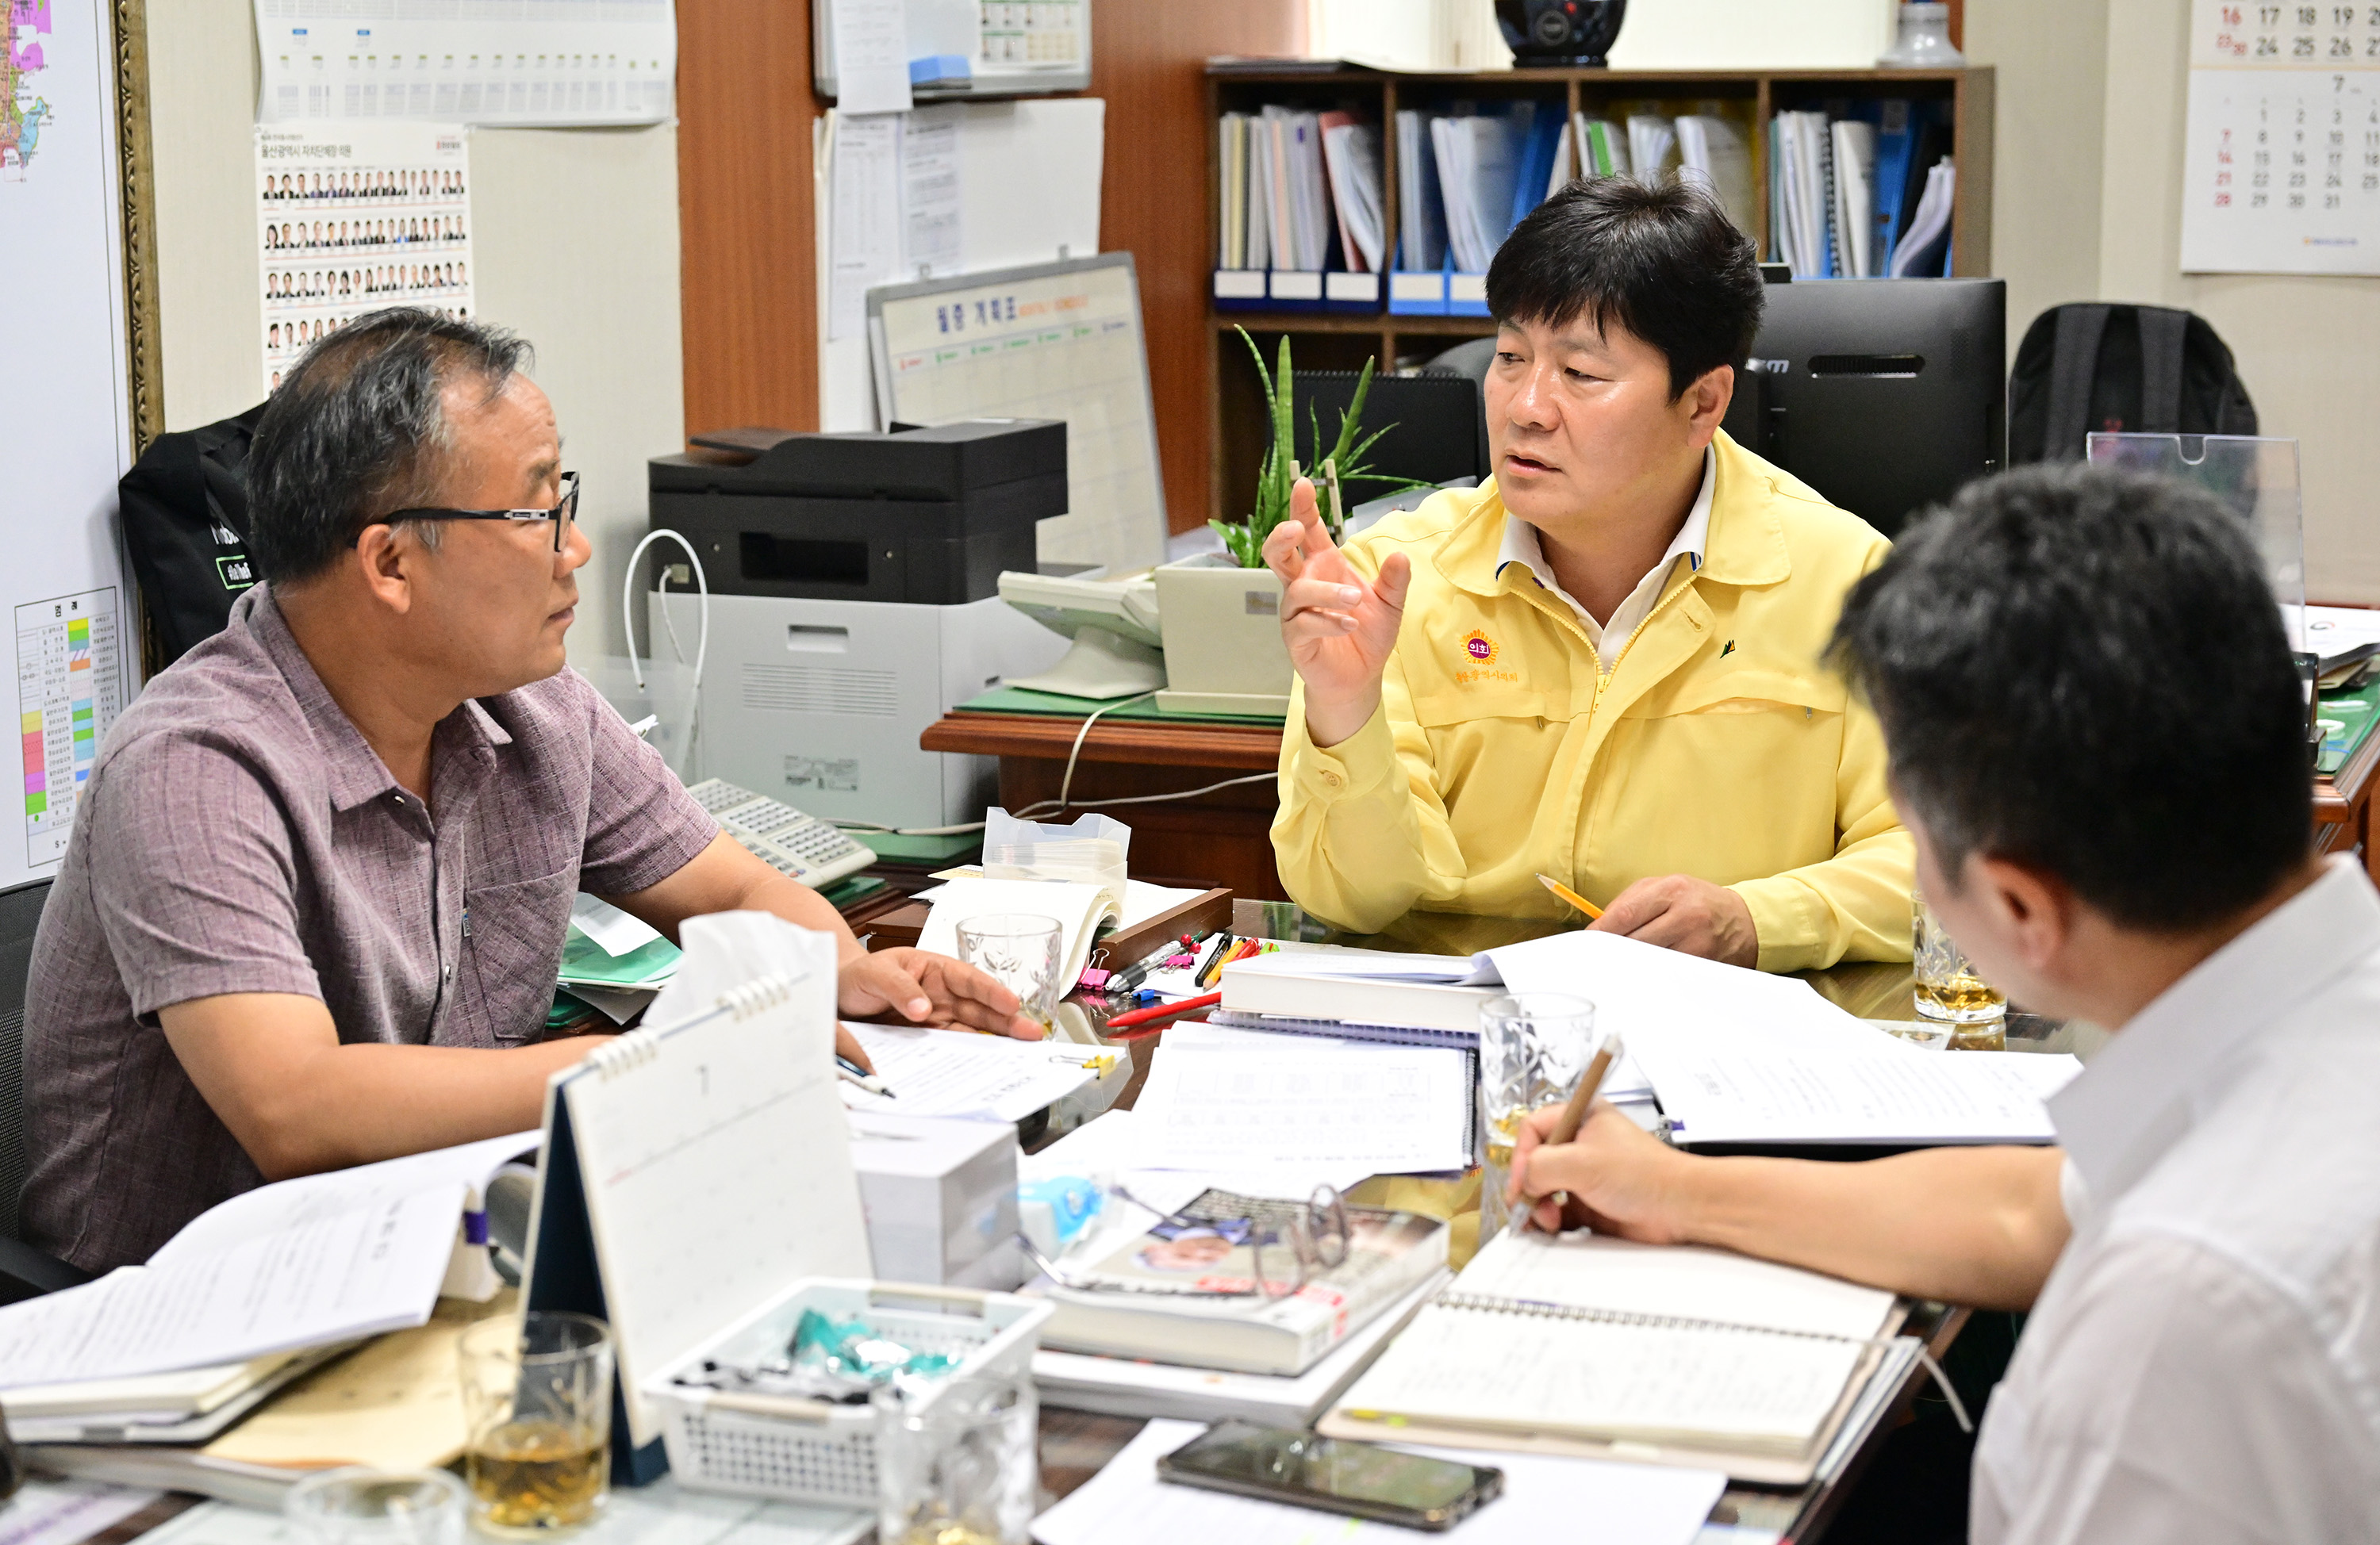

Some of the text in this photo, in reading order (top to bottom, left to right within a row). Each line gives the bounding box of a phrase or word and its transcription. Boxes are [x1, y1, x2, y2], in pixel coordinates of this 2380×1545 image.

[2221, 5, 2380, 27] 16 17 18 19 2
[2256, 36, 2278, 56] 24
[2294, 36, 2315, 56] 25
[2330, 36, 2353, 56] 26
[2333, 75, 2344, 92] 7
[2221, 128, 2231, 143] 7
[1468, 643, 1490, 654] 의회
